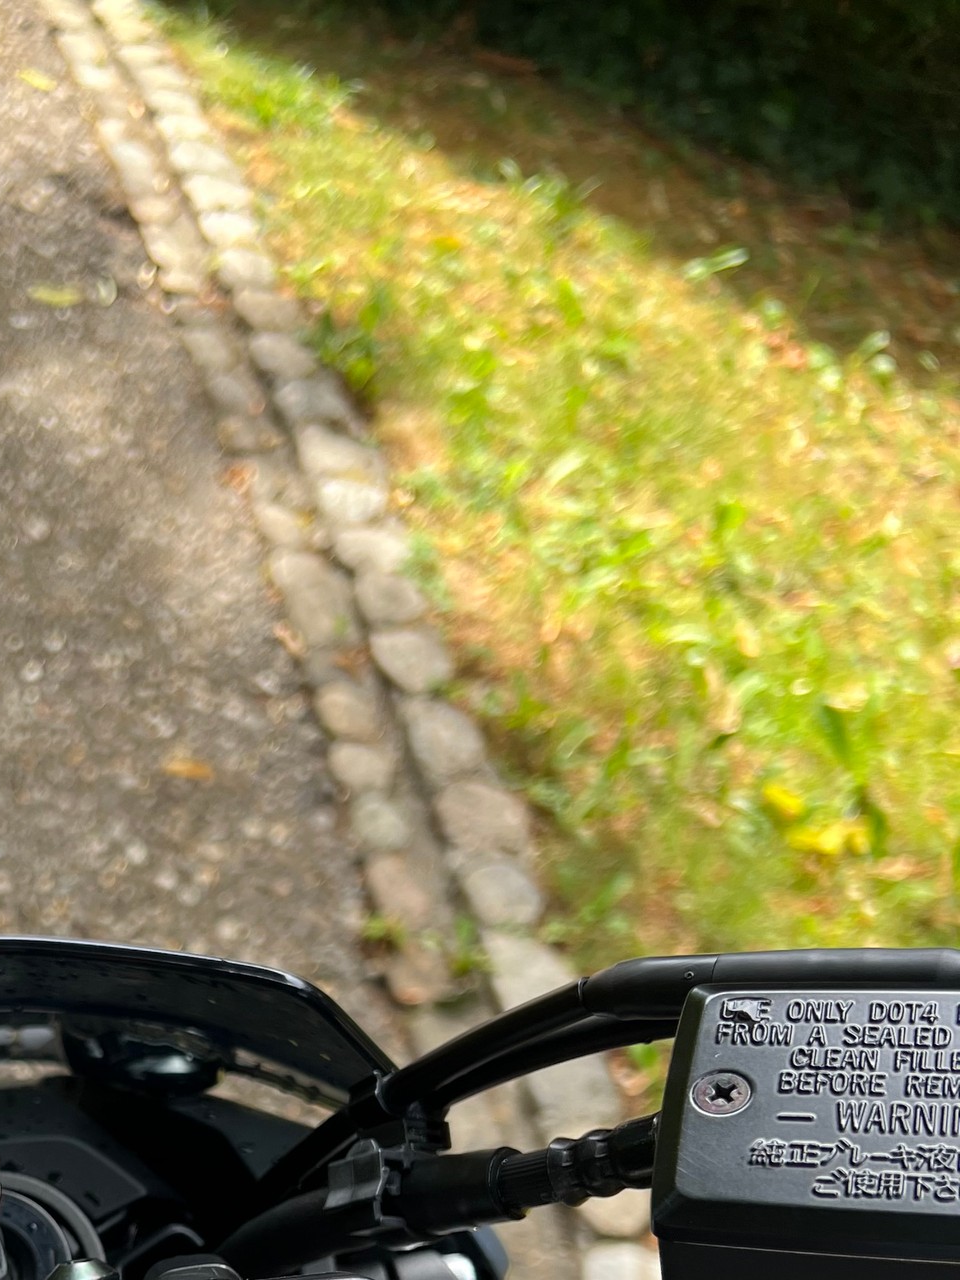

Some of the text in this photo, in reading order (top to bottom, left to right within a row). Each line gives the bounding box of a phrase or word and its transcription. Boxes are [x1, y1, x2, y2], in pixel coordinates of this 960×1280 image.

[720, 998, 771, 1020] UE
[787, 999, 855, 1024] ONLY
[869, 999, 940, 1024] DOT4
[716, 1022, 952, 1048] FROM A SEALED
[790, 1047, 880, 1071] CLEAN
[777, 1071, 887, 1096] BEFORE
[748, 1138, 960, 1172] 純正ブレーキ液
[812, 1166, 960, 1203] ご使用下さ
